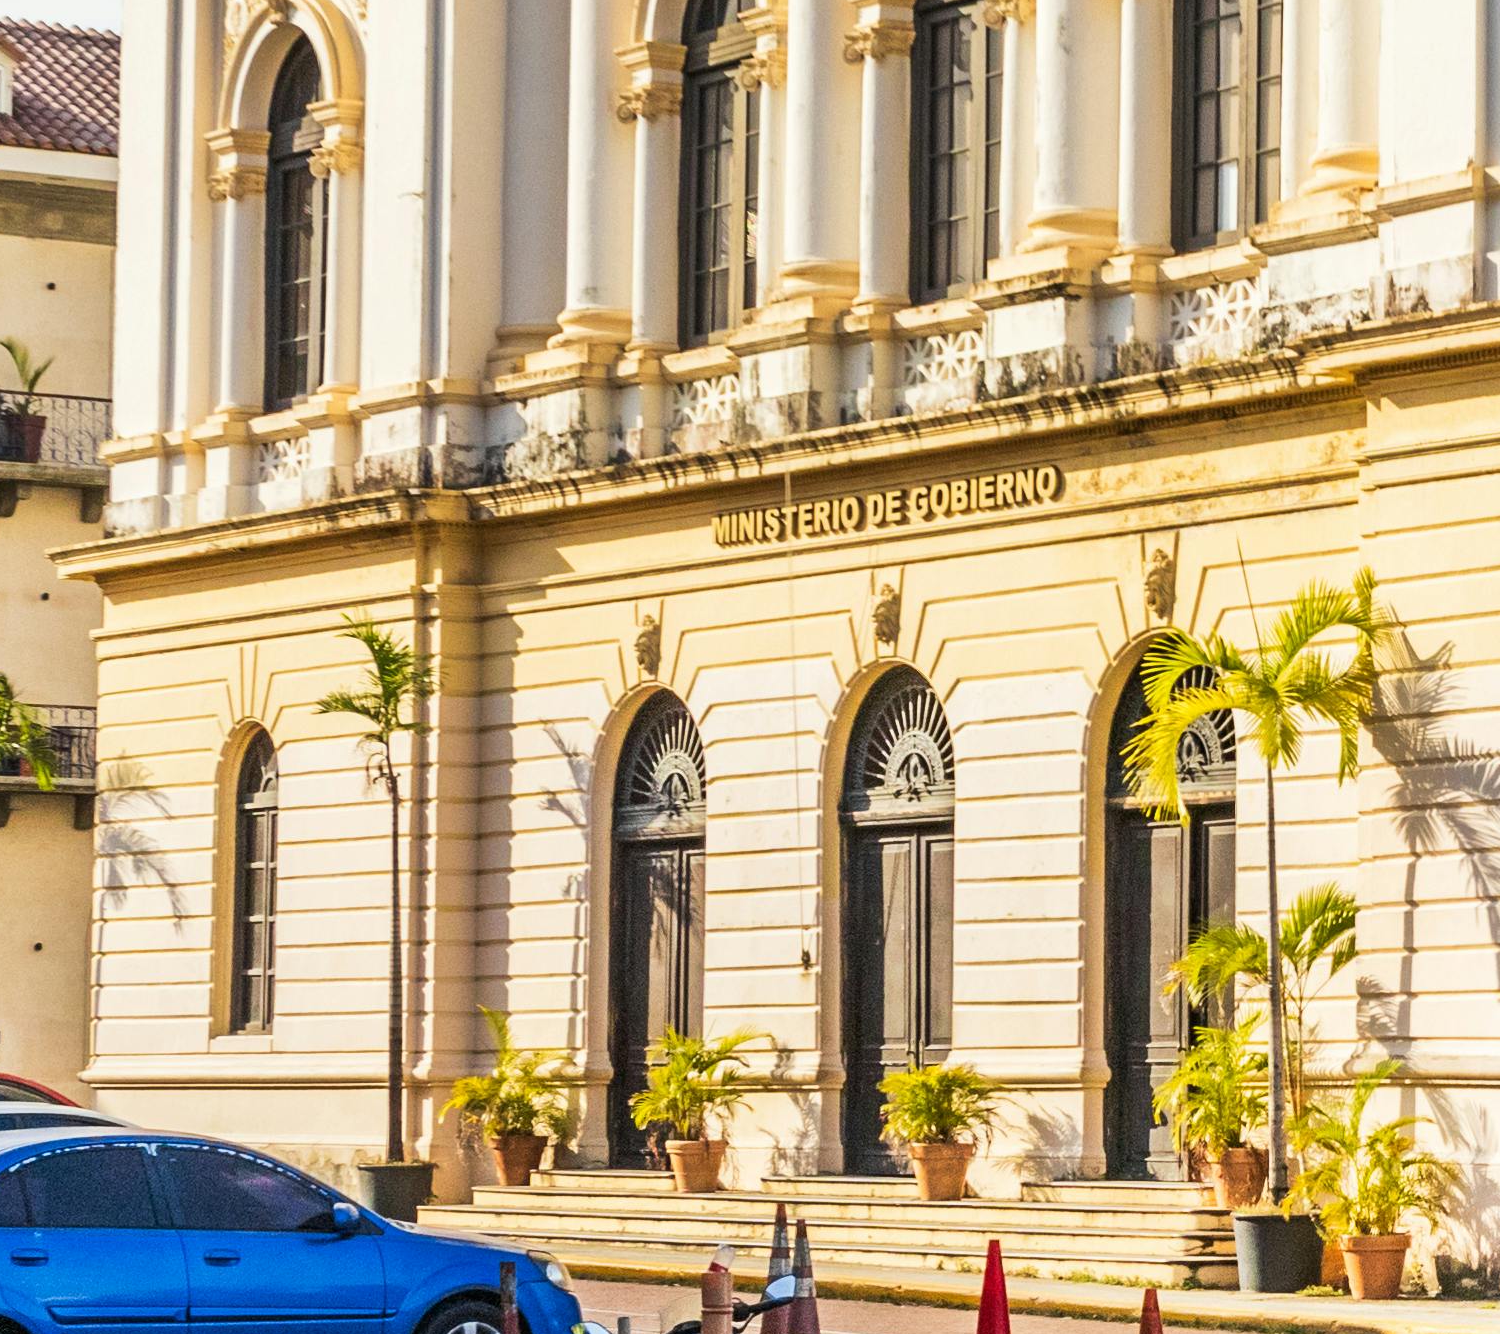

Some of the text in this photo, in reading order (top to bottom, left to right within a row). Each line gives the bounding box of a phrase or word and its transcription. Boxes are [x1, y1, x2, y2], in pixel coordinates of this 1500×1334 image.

[710, 465, 1061, 548] MINISTERIO DE GOBIERNO
